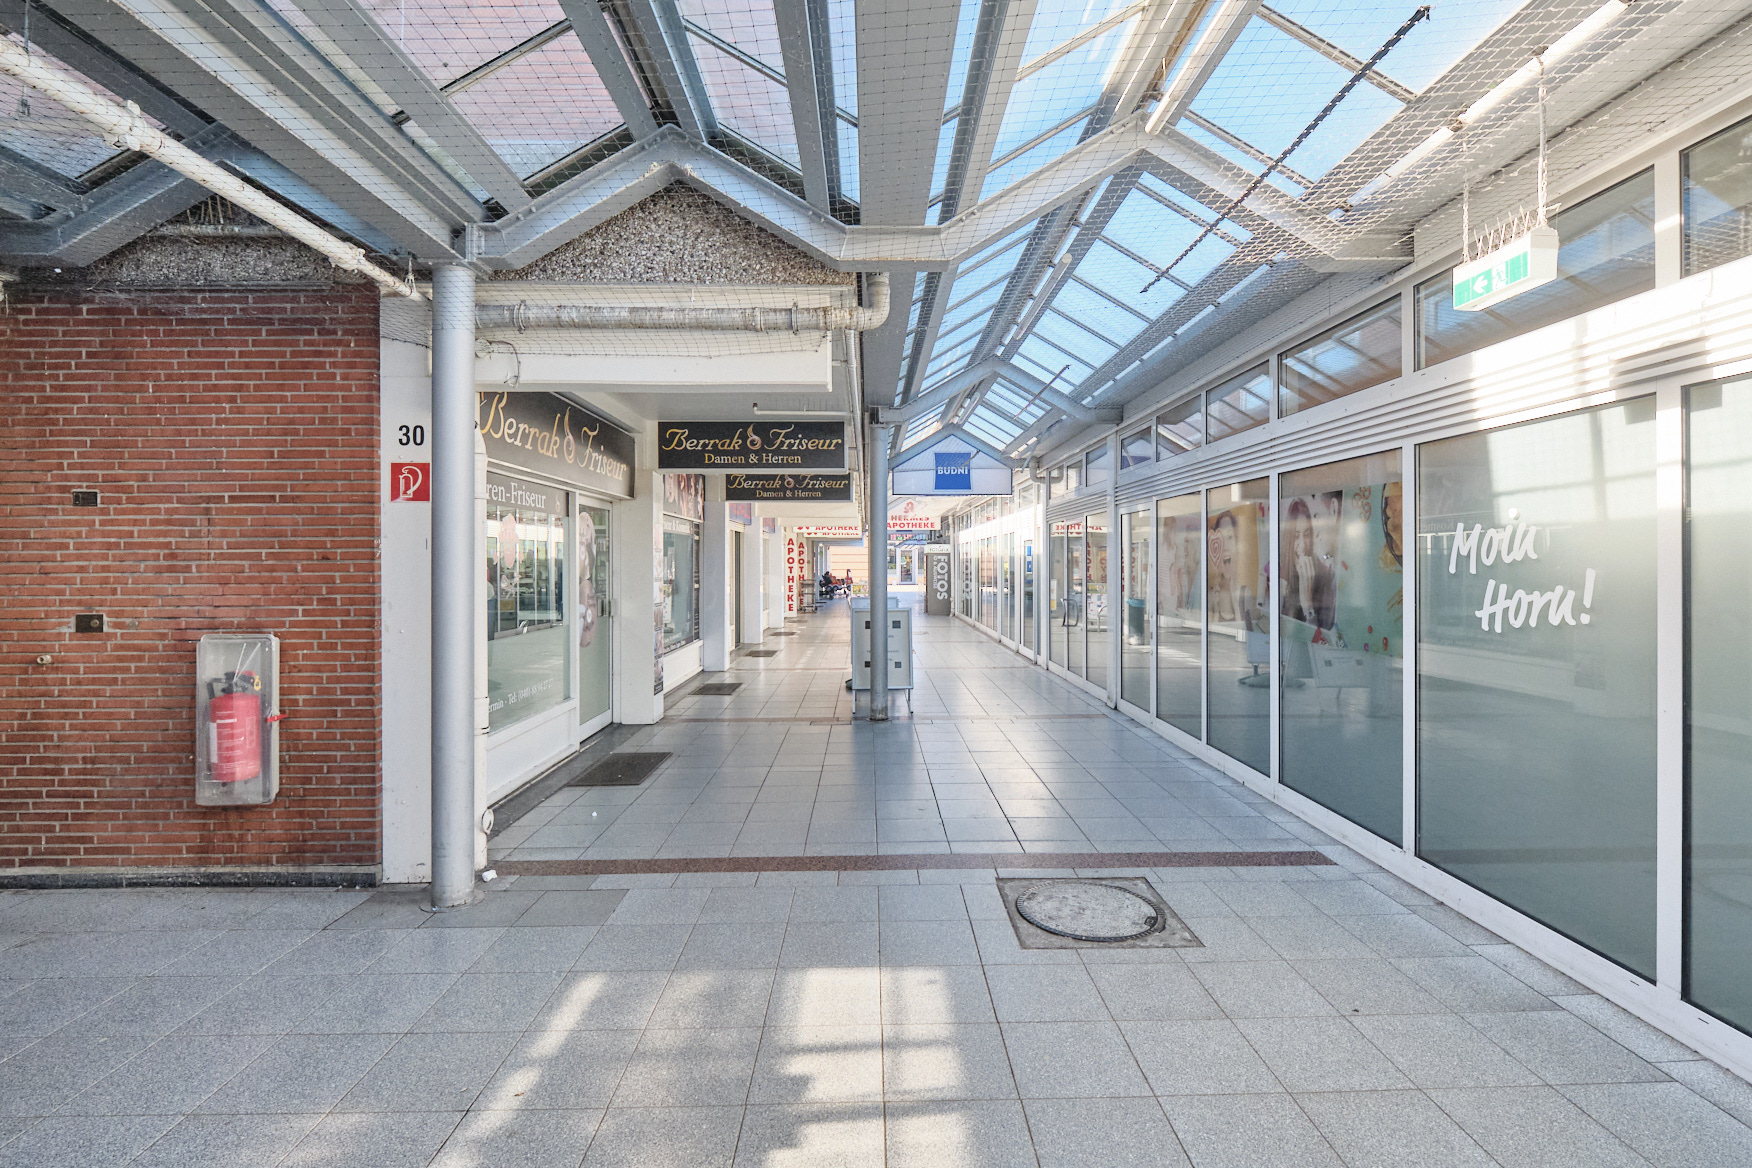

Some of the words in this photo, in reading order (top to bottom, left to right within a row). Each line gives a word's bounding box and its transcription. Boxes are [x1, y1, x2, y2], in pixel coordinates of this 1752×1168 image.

[398, 425, 425, 446] 30
[480, 392, 561, 459] Berrak
[577, 423, 627, 480] Friseur
[662, 428, 743, 450] Berrak
[764, 424, 842, 450] Friseur
[704, 453, 745, 464] Damen
[749, 453, 759, 464] &
[762, 453, 802, 464] Herren
[937, 466, 969, 475] BUDNI
[728, 474, 782, 489] Berrak
[795, 474, 849, 489] Friseur
[756, 490, 784, 498] Damen
[786, 490, 793, 498] &
[794, 490, 822, 498] Herren
[787, 538, 795, 612] APOTHEKE
[937, 555, 948, 600] FOTOS
